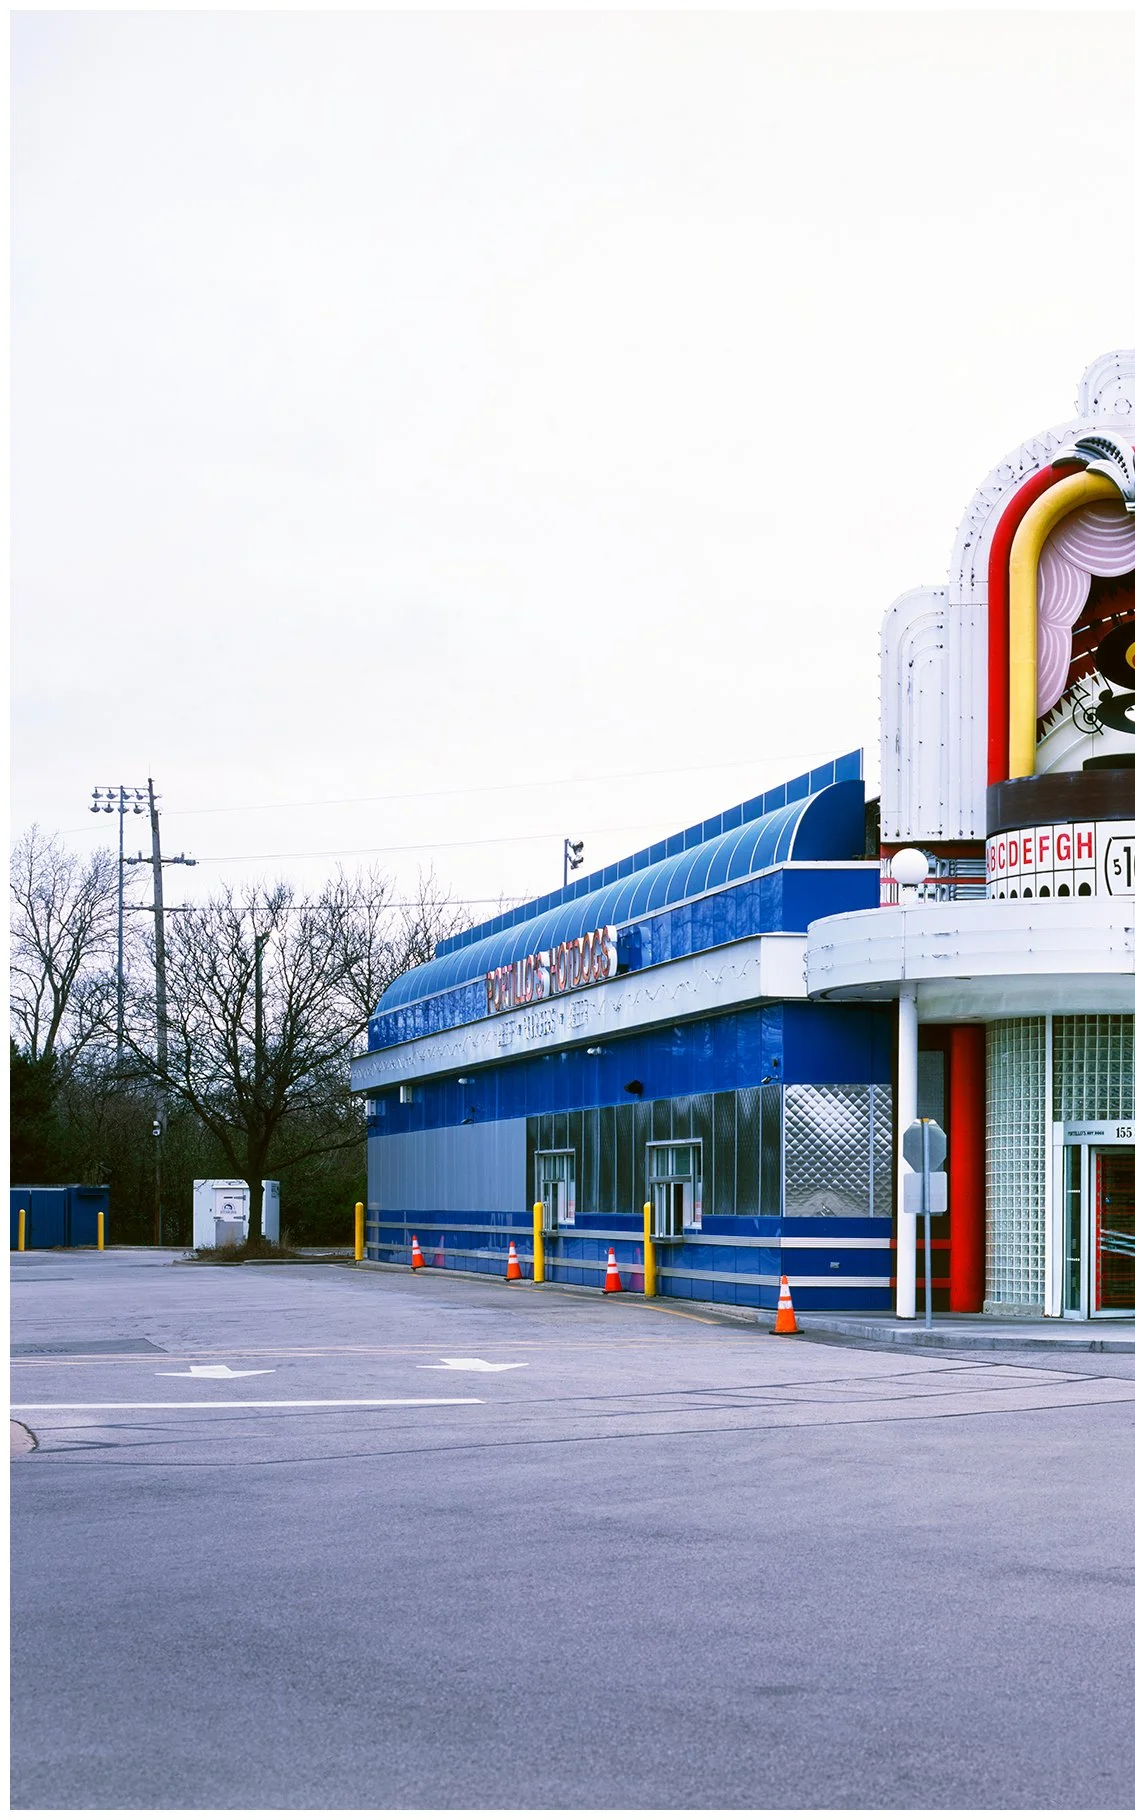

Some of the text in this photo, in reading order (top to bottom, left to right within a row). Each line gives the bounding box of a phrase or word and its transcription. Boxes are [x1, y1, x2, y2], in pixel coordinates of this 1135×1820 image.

[1113, 857, 1123, 876] 5
[486, 950, 550, 1015] PORTILLO'S
[550, 925, 615, 994] HOTDOGS
[1116, 1126, 1132, 1138] 155
